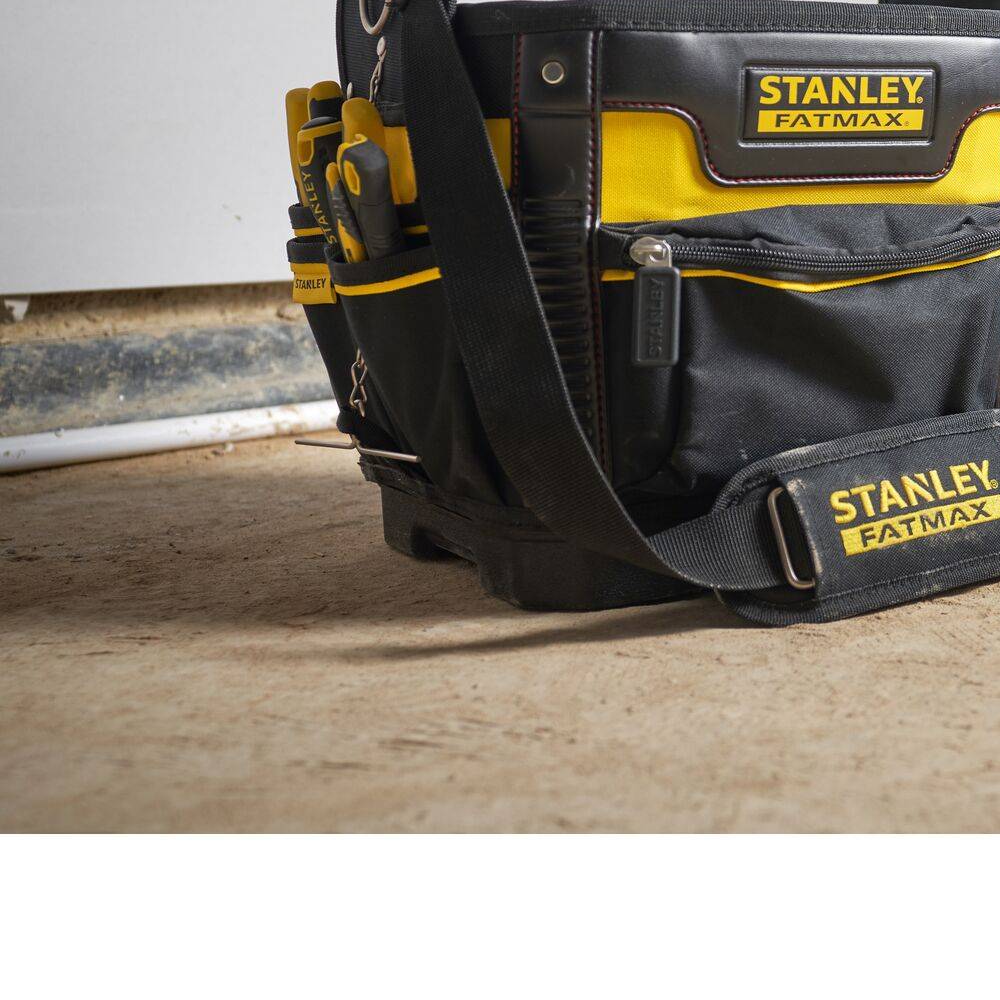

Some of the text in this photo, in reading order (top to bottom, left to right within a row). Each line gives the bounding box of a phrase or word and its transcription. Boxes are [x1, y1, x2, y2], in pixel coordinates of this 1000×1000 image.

[759, 75, 924, 105] STANLEY
[775, 112, 904, 128] FATMAX
[301, 171, 338, 245] STANLEY
[295, 278, 327, 290] STANLEY
[830, 459, 992, 524] STANLEY
[860, 501, 992, 548] FATMAX
